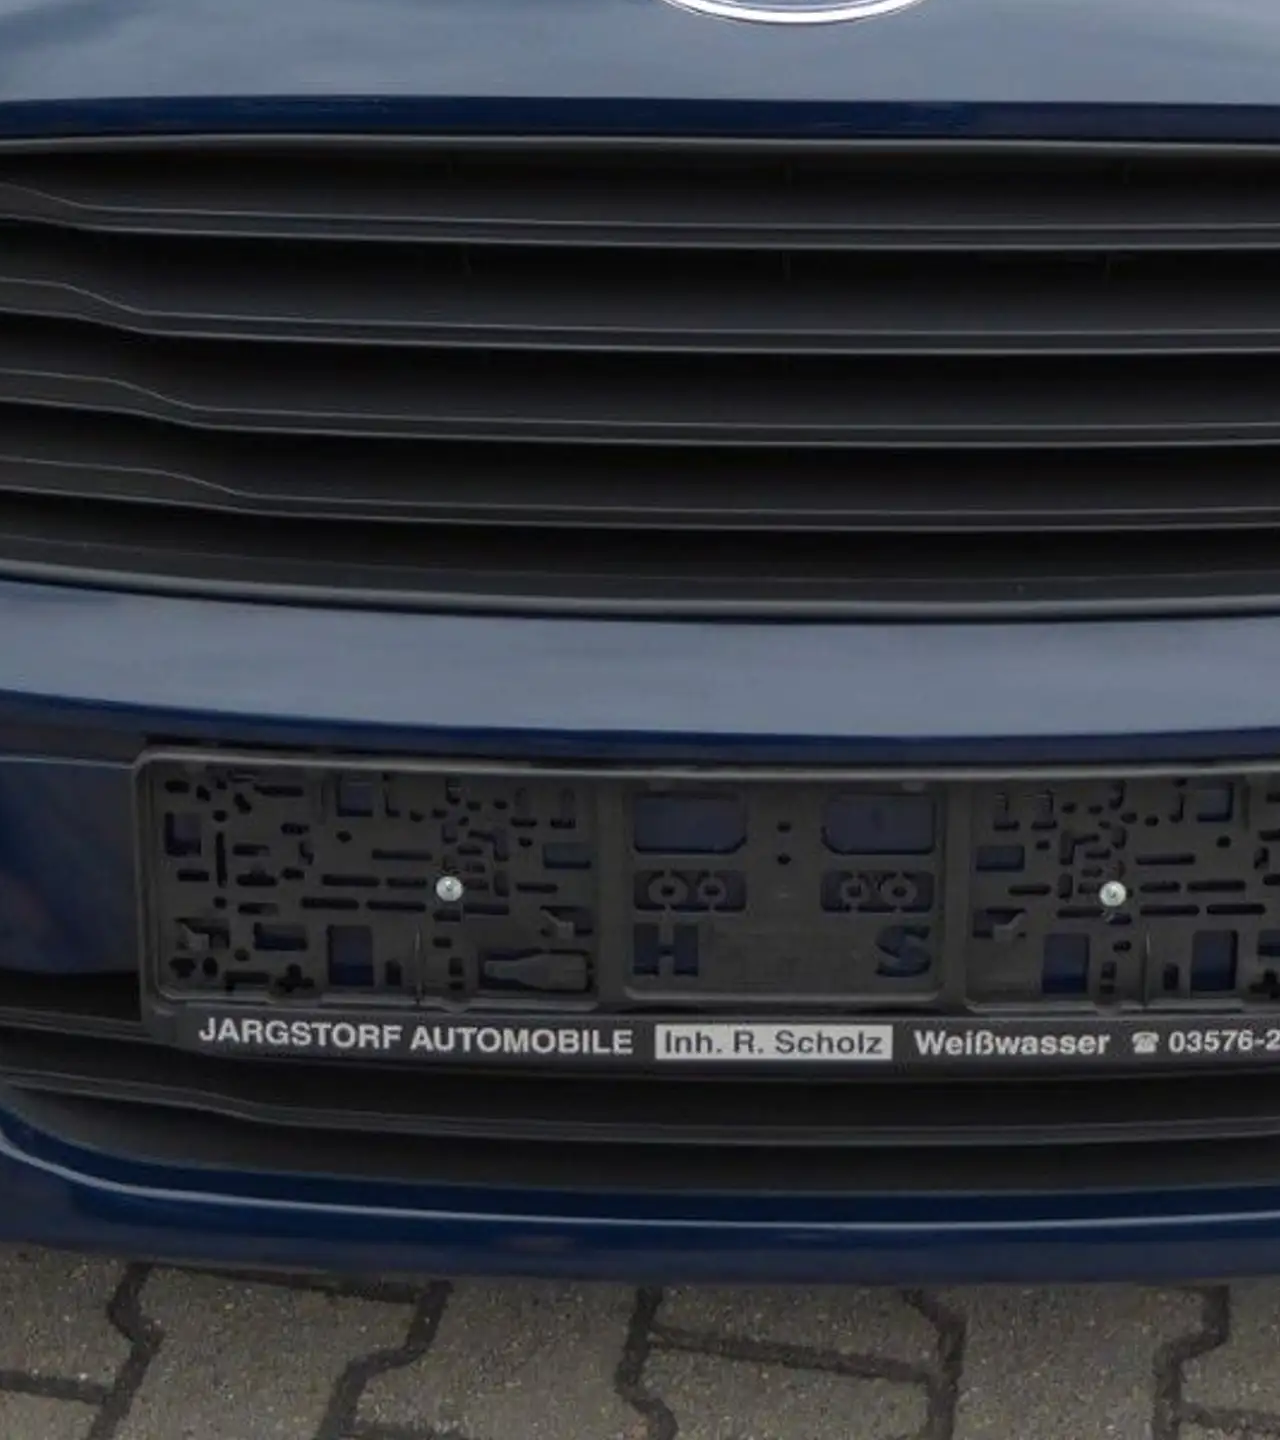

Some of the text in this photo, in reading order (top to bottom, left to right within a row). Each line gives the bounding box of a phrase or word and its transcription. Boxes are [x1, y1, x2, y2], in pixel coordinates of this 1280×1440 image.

[198, 1016, 403, 1051] JARGSTORF
[409, 1025, 635, 1055] AUTOMOBILE
[665, 1030, 722, 1054] Inh.
[733, 1030, 764, 1054] R.
[775, 1030, 883, 1055] Scholz
[914, 1030, 1111, 1056] Weißwasser
